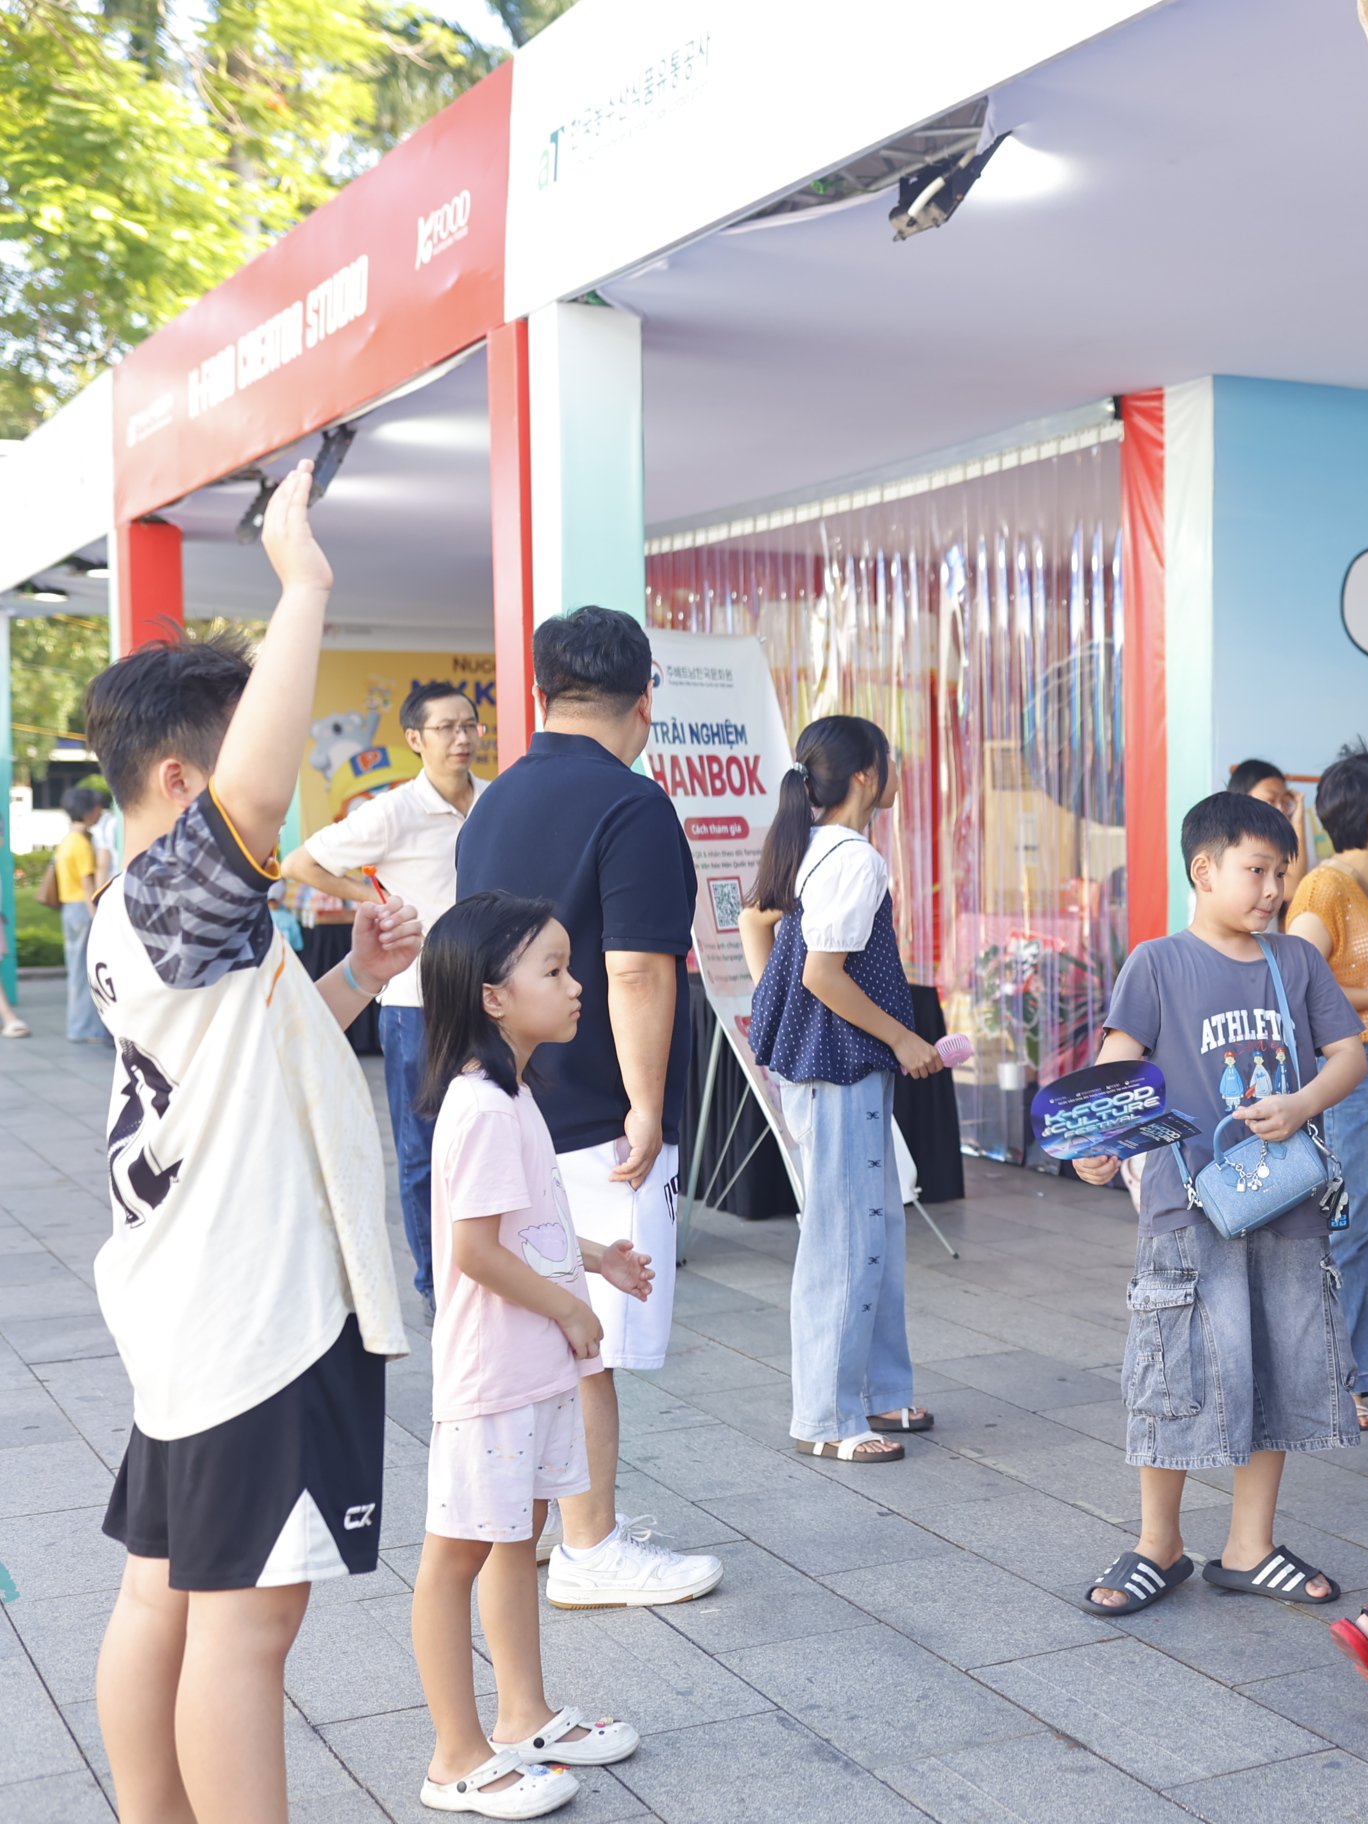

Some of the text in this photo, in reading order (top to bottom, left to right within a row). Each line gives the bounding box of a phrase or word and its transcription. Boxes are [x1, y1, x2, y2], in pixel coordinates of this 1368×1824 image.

[306, 254, 369, 348] STUDIO
[651, 716, 748, 750] TRẢI NGHIỆM
[648, 753, 767, 797] HANBOK
[1200, 1008, 1296, 1055] ATHLET
[1044, 1085, 1156, 1126] K-FOOD
[1064, 1113, 1142, 1139] FESTIVAL
